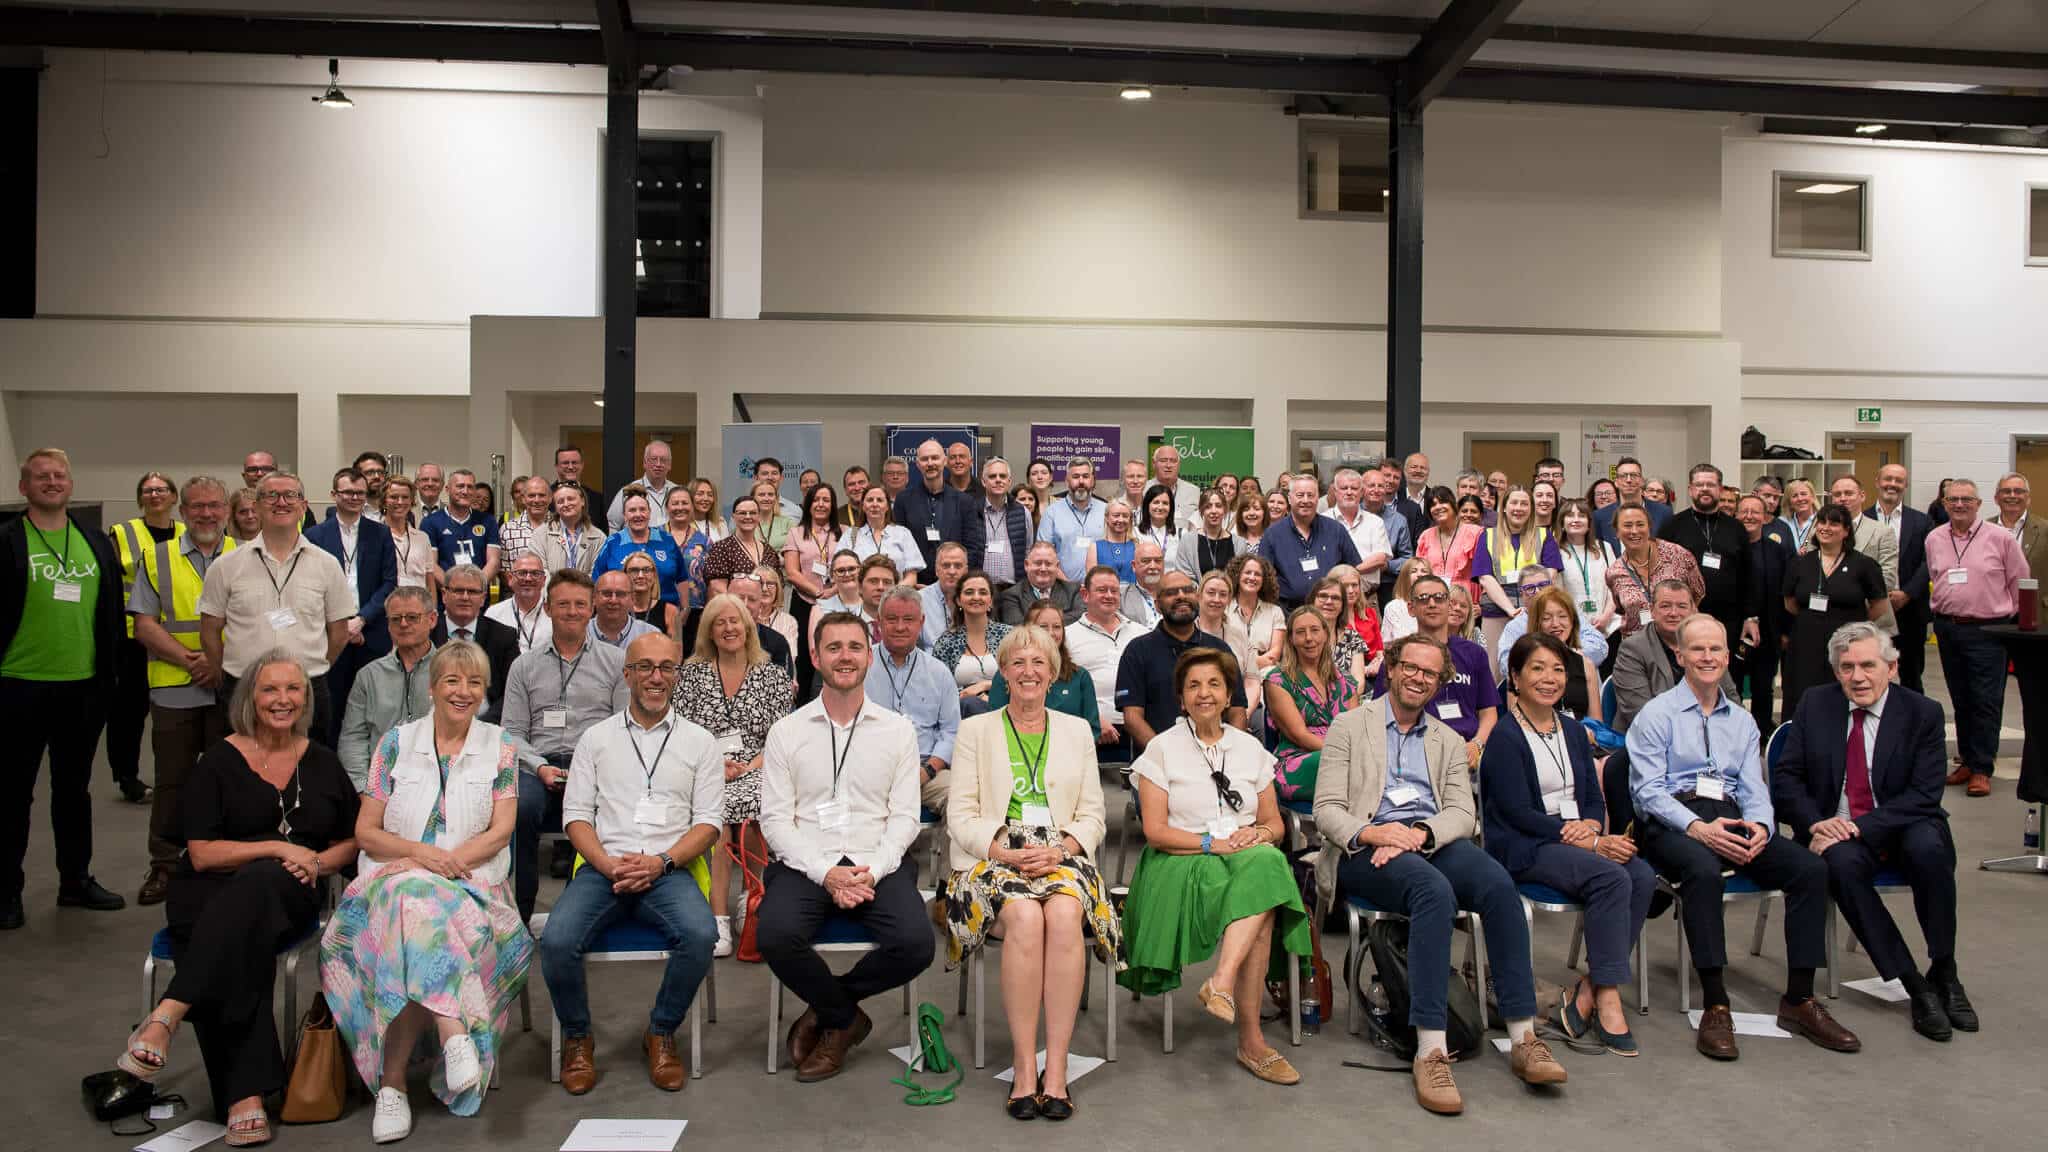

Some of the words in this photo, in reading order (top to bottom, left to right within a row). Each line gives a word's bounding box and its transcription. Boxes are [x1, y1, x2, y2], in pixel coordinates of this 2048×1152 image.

[1036, 435, 1079, 445] Supporting
[1080, 437, 1104, 446] young
[1036, 445, 1064, 453] people
[1075, 446, 1093, 454] gain
[1094, 446, 1115, 454] skills,
[1173, 436, 1216, 460] Felix
[1090, 455, 1105, 463] and
[29, 552, 97, 582] Felix
